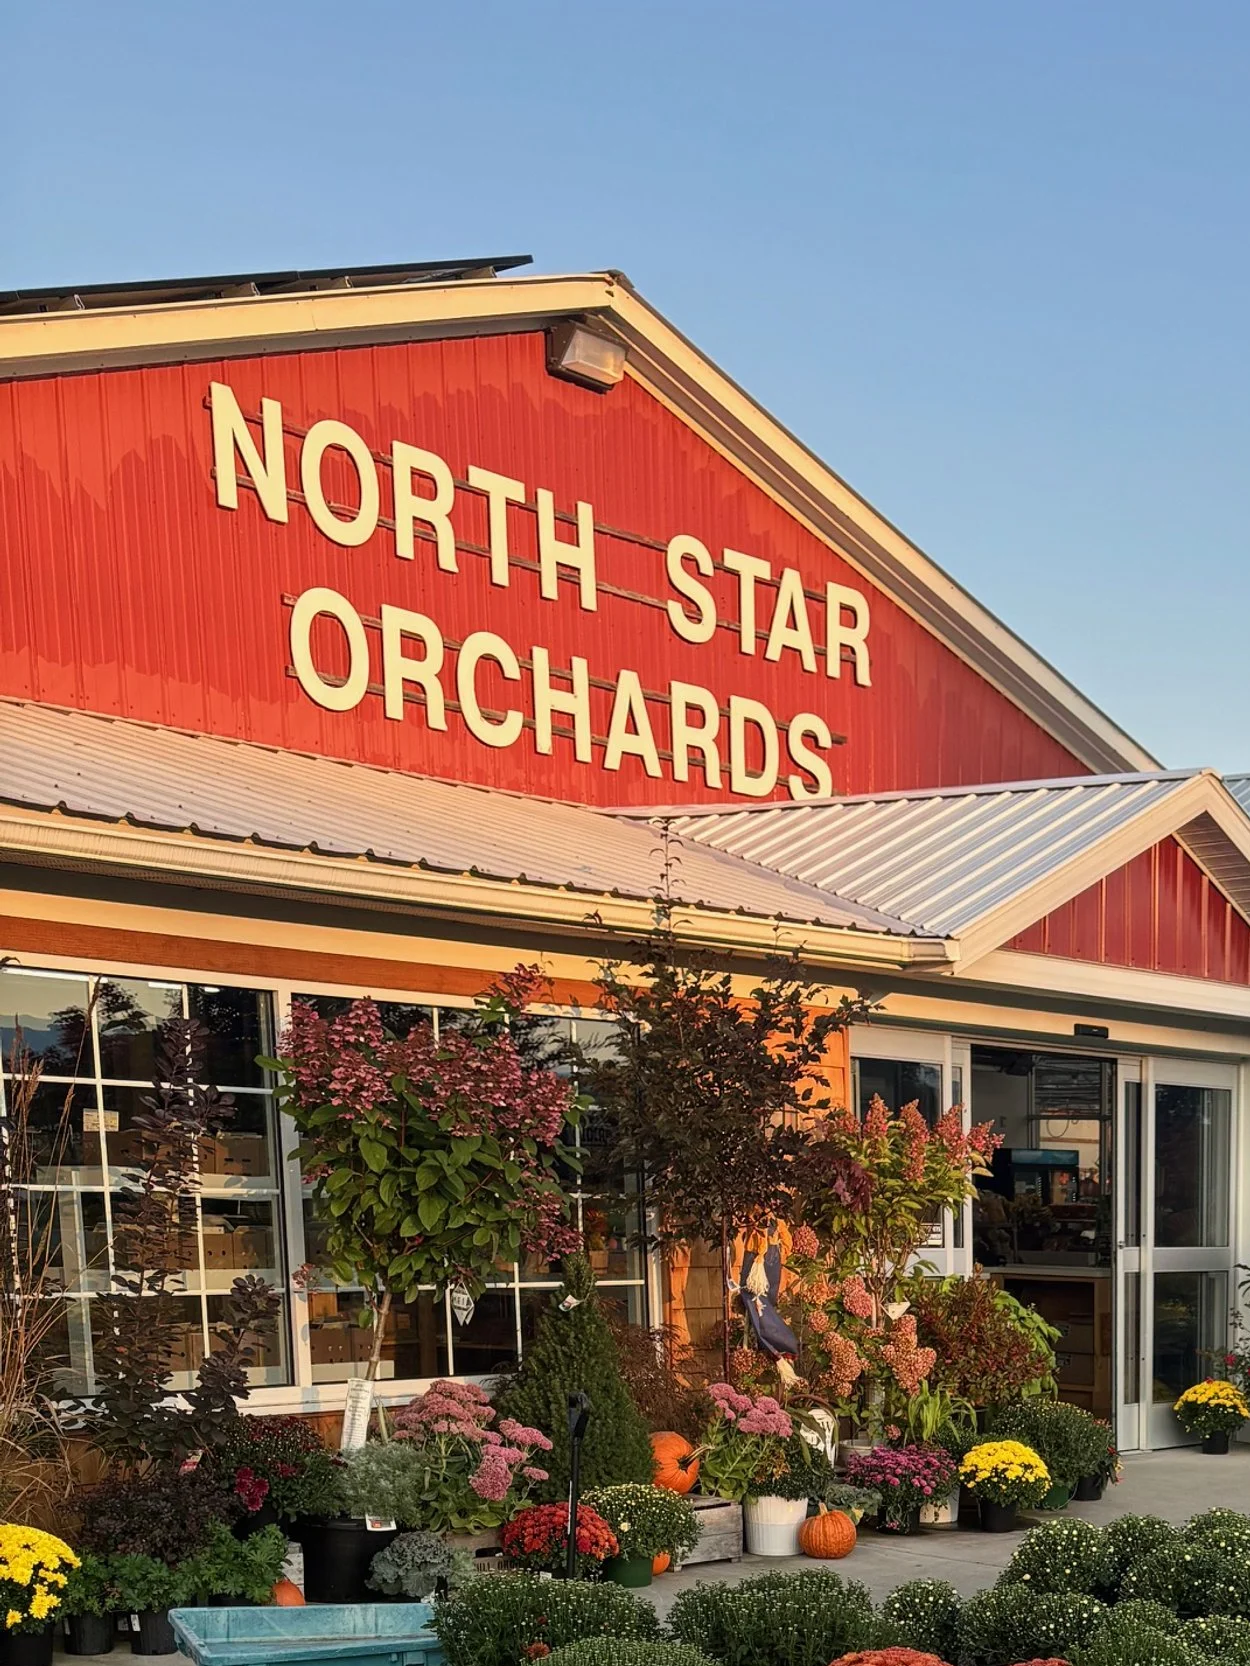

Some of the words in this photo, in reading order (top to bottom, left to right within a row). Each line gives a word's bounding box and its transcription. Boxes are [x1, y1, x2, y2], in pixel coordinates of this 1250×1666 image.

[209, 380, 598, 612] NORTH
[665, 533, 873, 688] STAR
[288, 586, 834, 799] ORCHARDS
